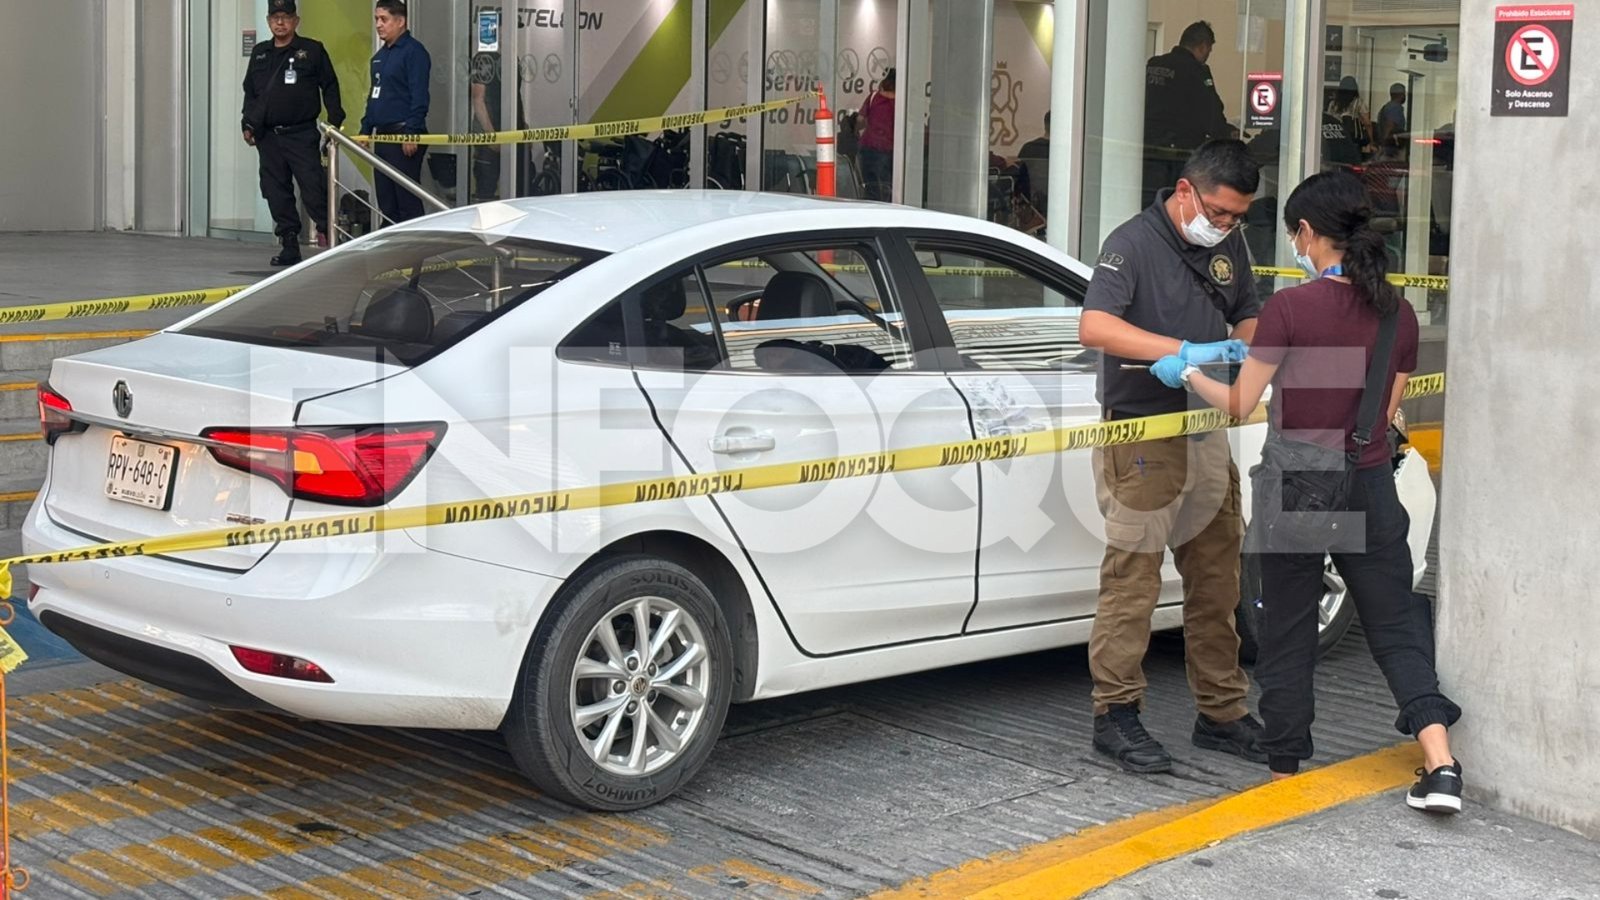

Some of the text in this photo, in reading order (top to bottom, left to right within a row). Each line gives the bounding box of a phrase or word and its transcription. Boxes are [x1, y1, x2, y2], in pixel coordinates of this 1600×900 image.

[1499, 9, 1571, 18] Prohibido Estacionarse
[842, 72, 865, 94] de
[1505, 90, 1553, 98] Solo Ascenso
[1508, 100, 1551, 109] y Descenso
[594, 121, 640, 136] PRECAUCION
[660, 113, 705, 129] PRECAUCION
[447, 134, 497, 143] PRECAUCION
[522, 128, 569, 141] PRECAUCION
[1066, 421, 1146, 450] PRECAUCION
[939, 437, 1028, 466] PRECAUCION
[107, 453, 167, 489] RPV-648-C
[799, 454, 896, 483] PRECAUCION
[635, 473, 743, 502] PRECAUCION
[630, 573, 689, 591] SOLUS
